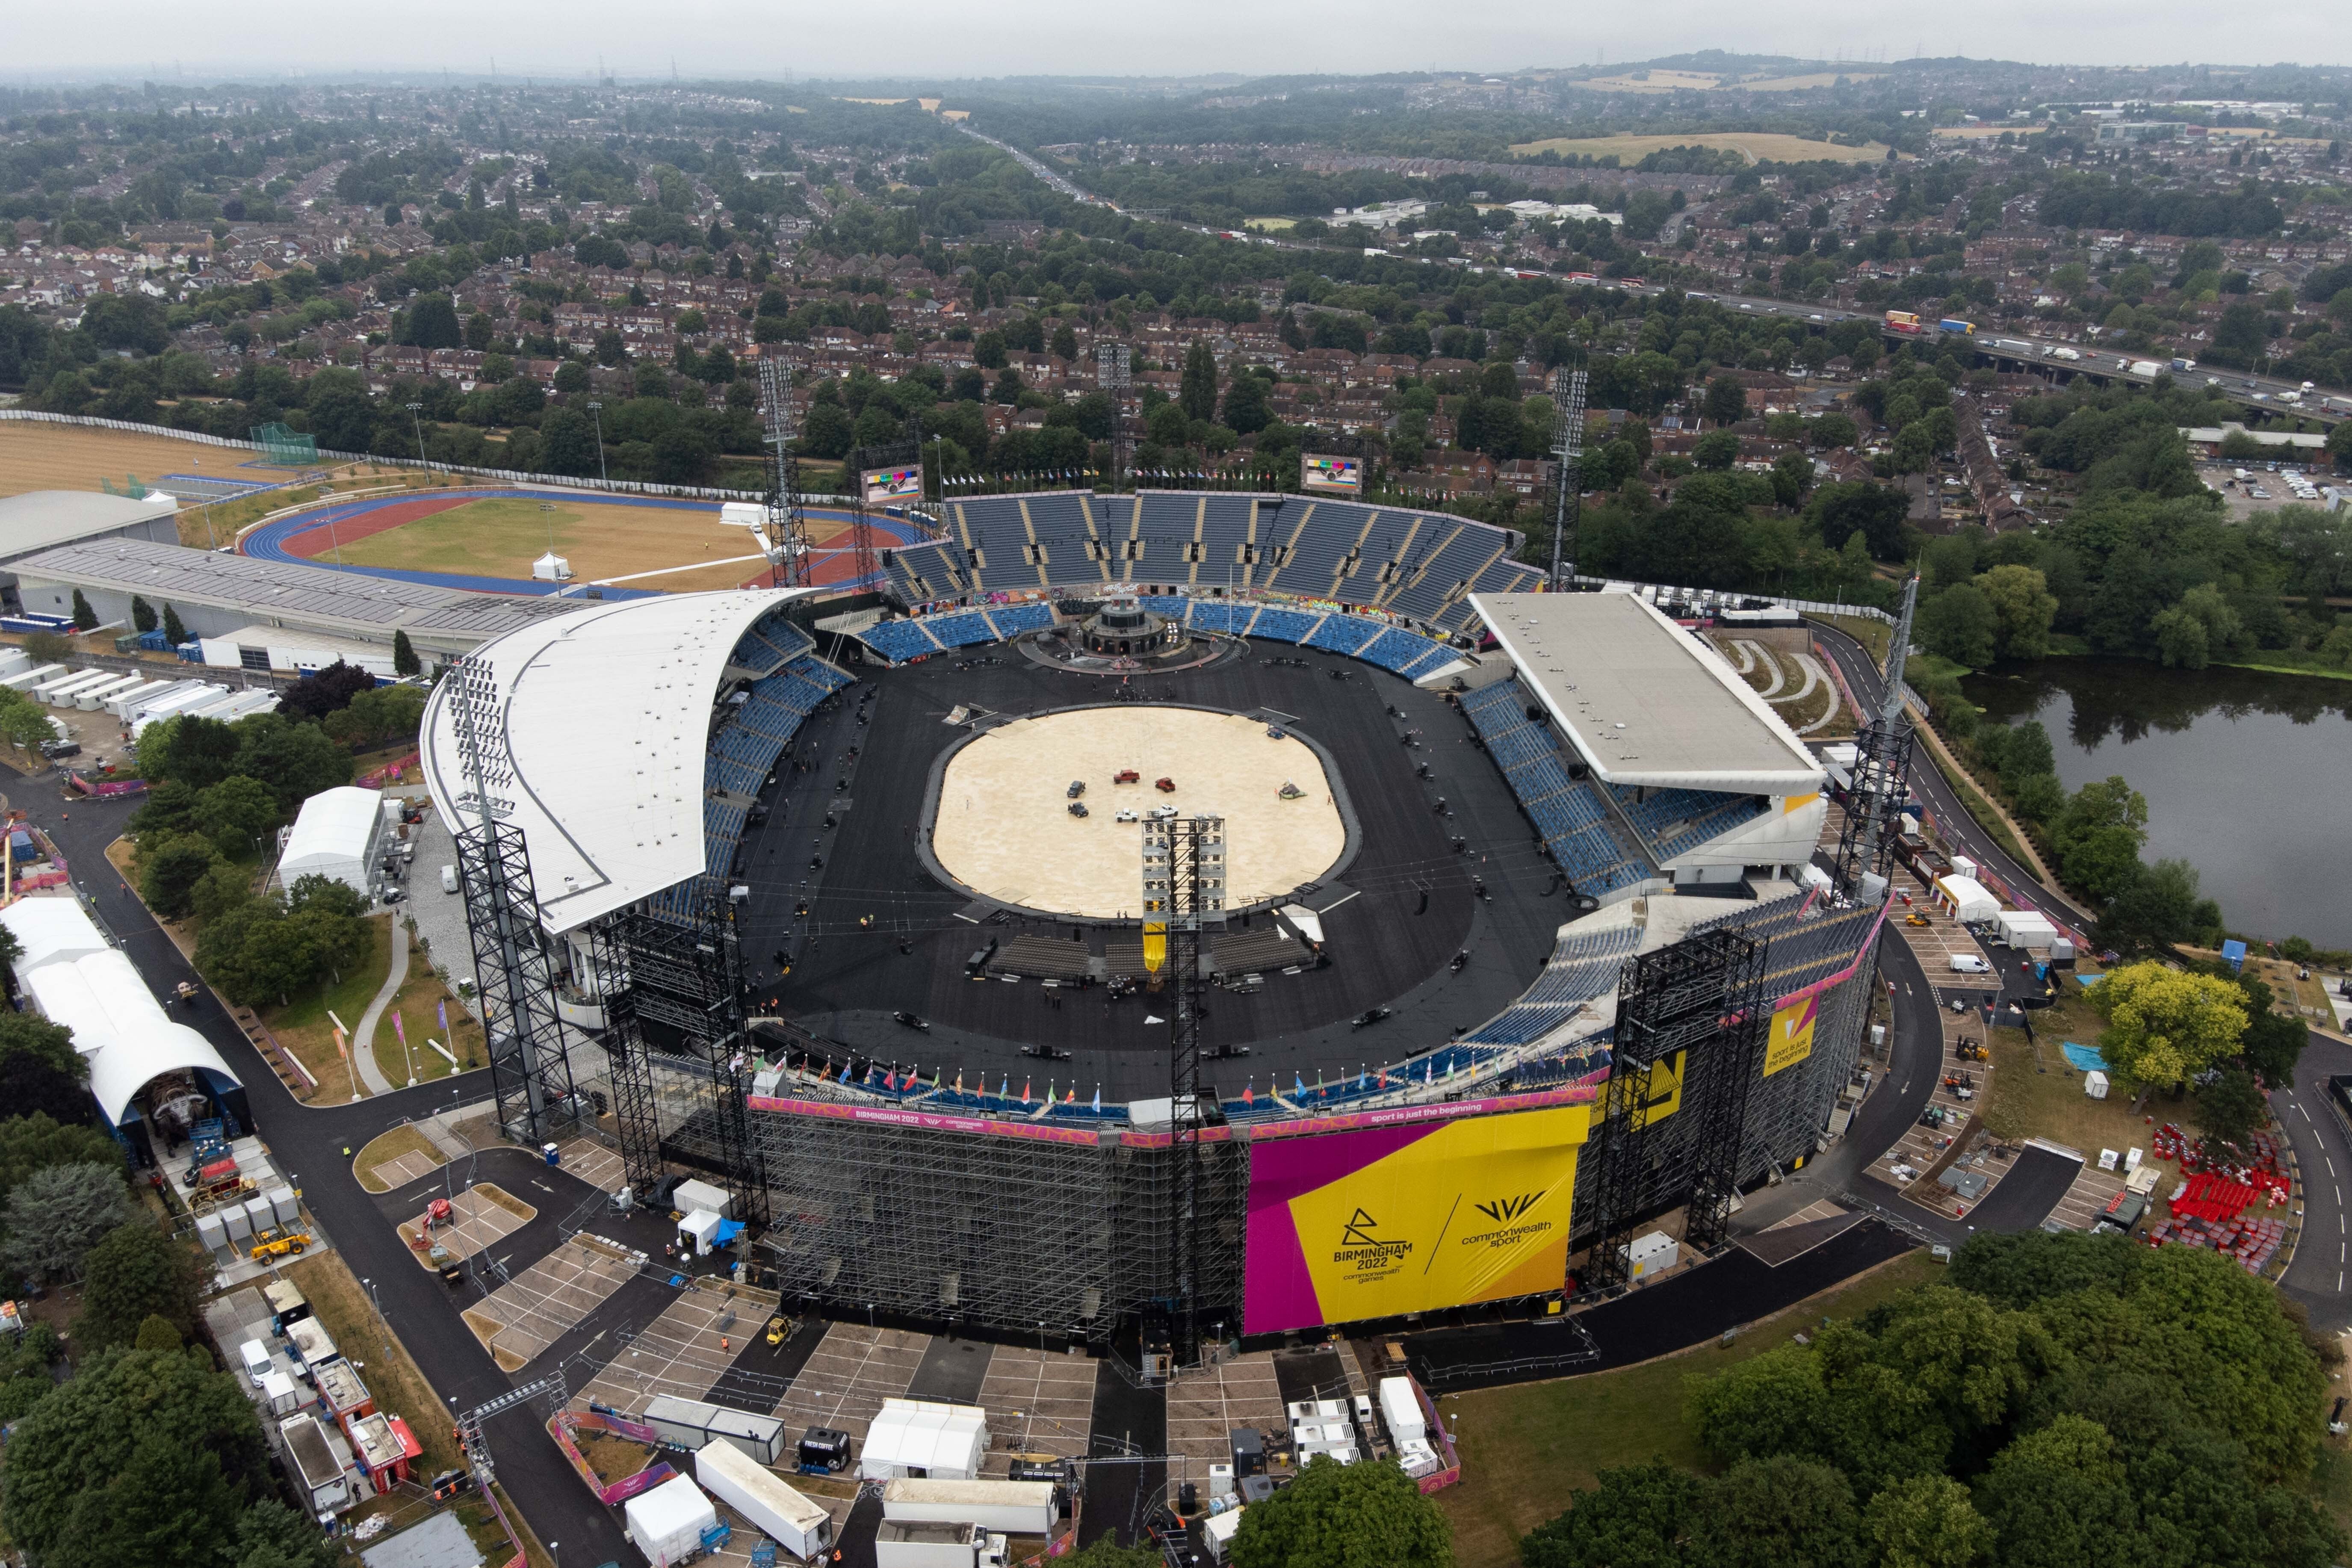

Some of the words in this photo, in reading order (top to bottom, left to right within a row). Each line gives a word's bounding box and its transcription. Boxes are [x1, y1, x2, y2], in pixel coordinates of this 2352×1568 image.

[1772, 1047, 1788, 1059] sport
[1796, 1038, 1807, 1050] just
[1768, 1060, 1778, 1068] the
[1779, 1045, 1808, 1063] beginning
[856, 1110, 900, 1122] BIRMINGHAM
[902, 1115, 919, 1124] 2022
[1371, 1113, 1395, 1123] sport
[1406, 1111, 1421, 1119] just
[1439, 1104, 1482, 1114] beginning
[1462, 1221, 1551, 1245] commonwealth
[1490, 1235, 1521, 1247] sport
[1334, 1243, 1412, 1262] BIRMINGHAM
[1357, 1257, 1388, 1270] 2022
[1343, 1268, 1400, 1280] commonwealth
[1358, 1275, 1384, 1285] games
[805, 1440, 818, 1449] FRESH
[818, 1442, 834, 1451] COFFEE
[839, 1433, 848, 1447] COFFEE
